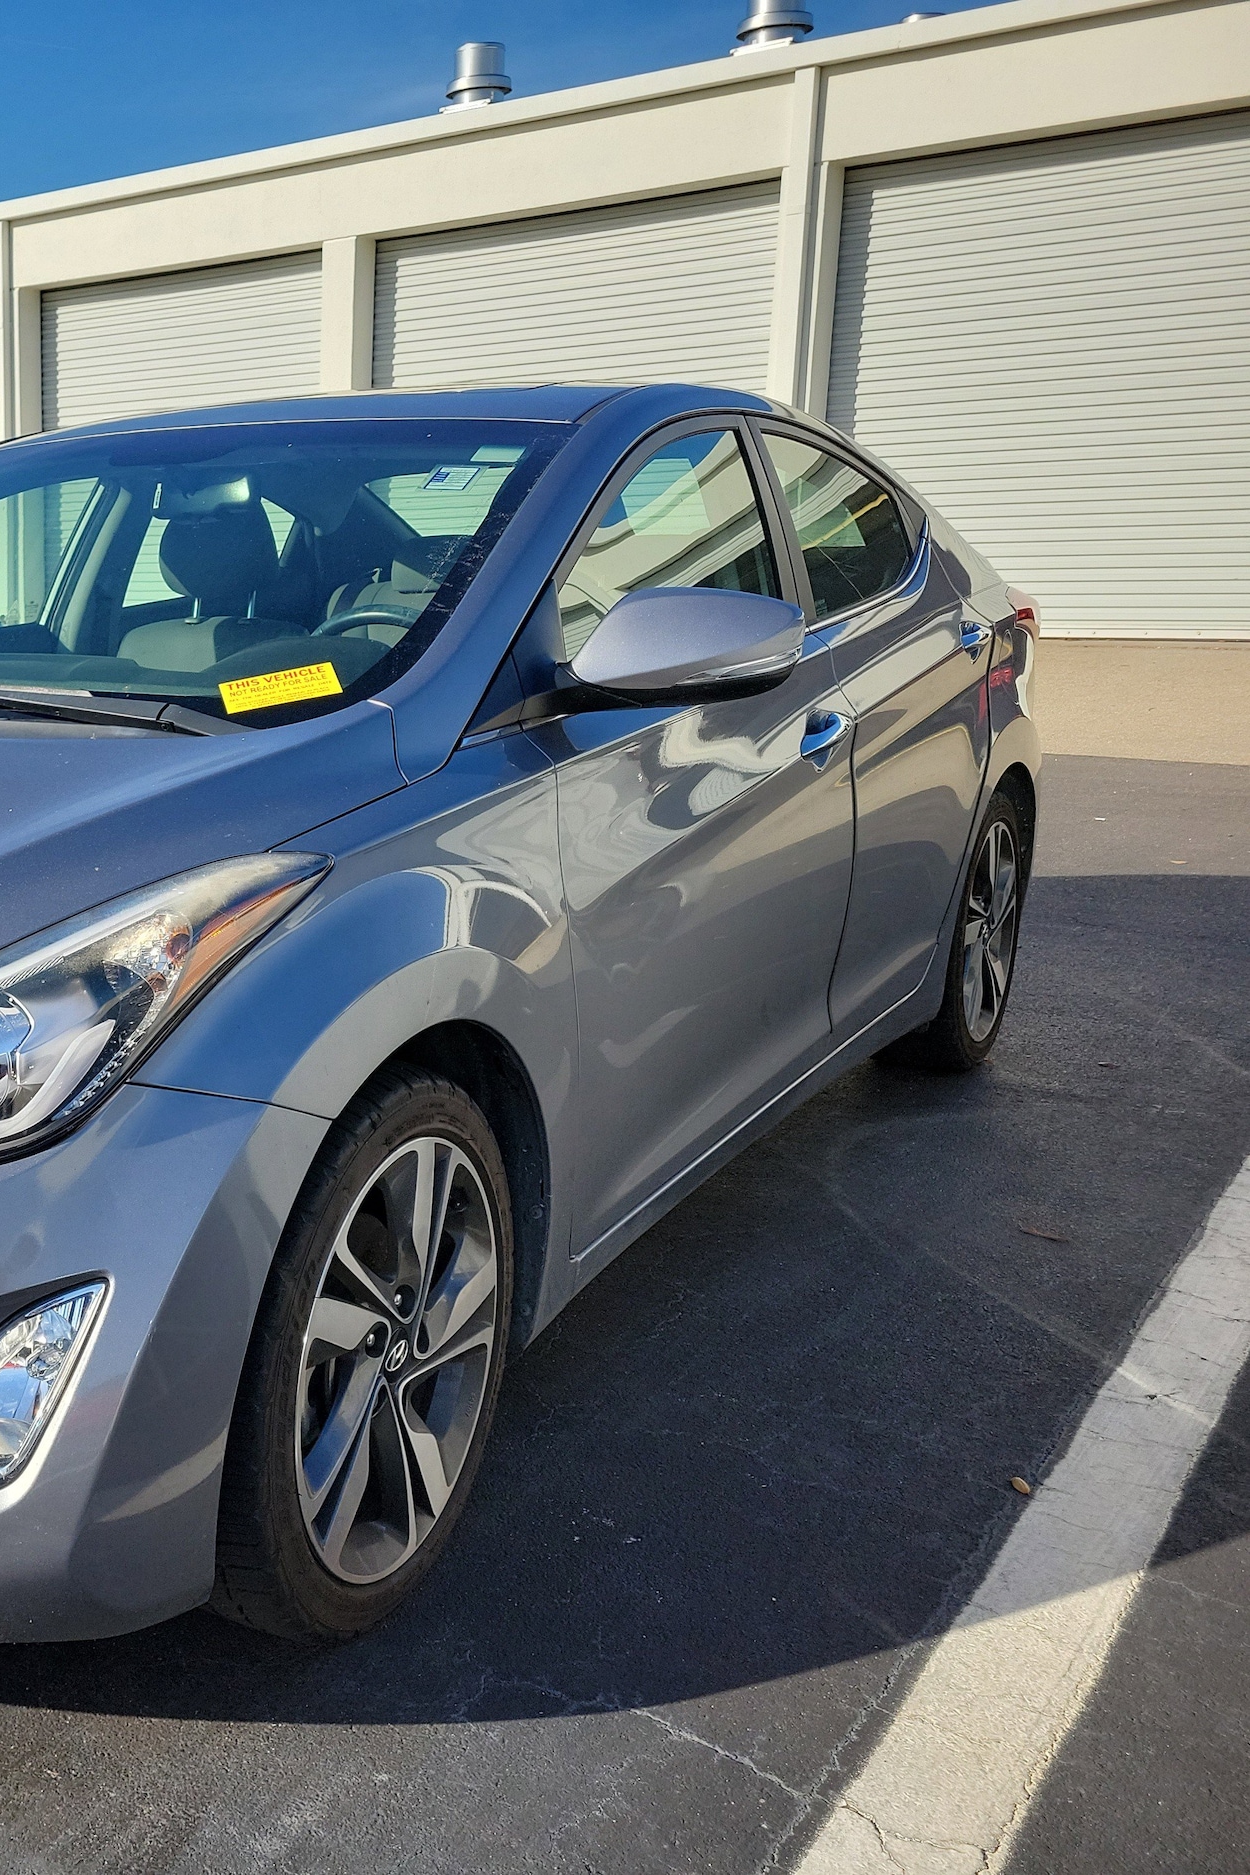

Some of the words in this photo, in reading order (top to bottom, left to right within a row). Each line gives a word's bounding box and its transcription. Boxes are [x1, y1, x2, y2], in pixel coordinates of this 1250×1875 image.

[226, 679, 260, 691] THIS
[263, 665, 326, 683] VEHICLE
[229, 689, 248, 698] NOT
[250, 682, 281, 693] READY
[283, 678, 302, 687] FOR
[303, 673, 328, 683] SALE
